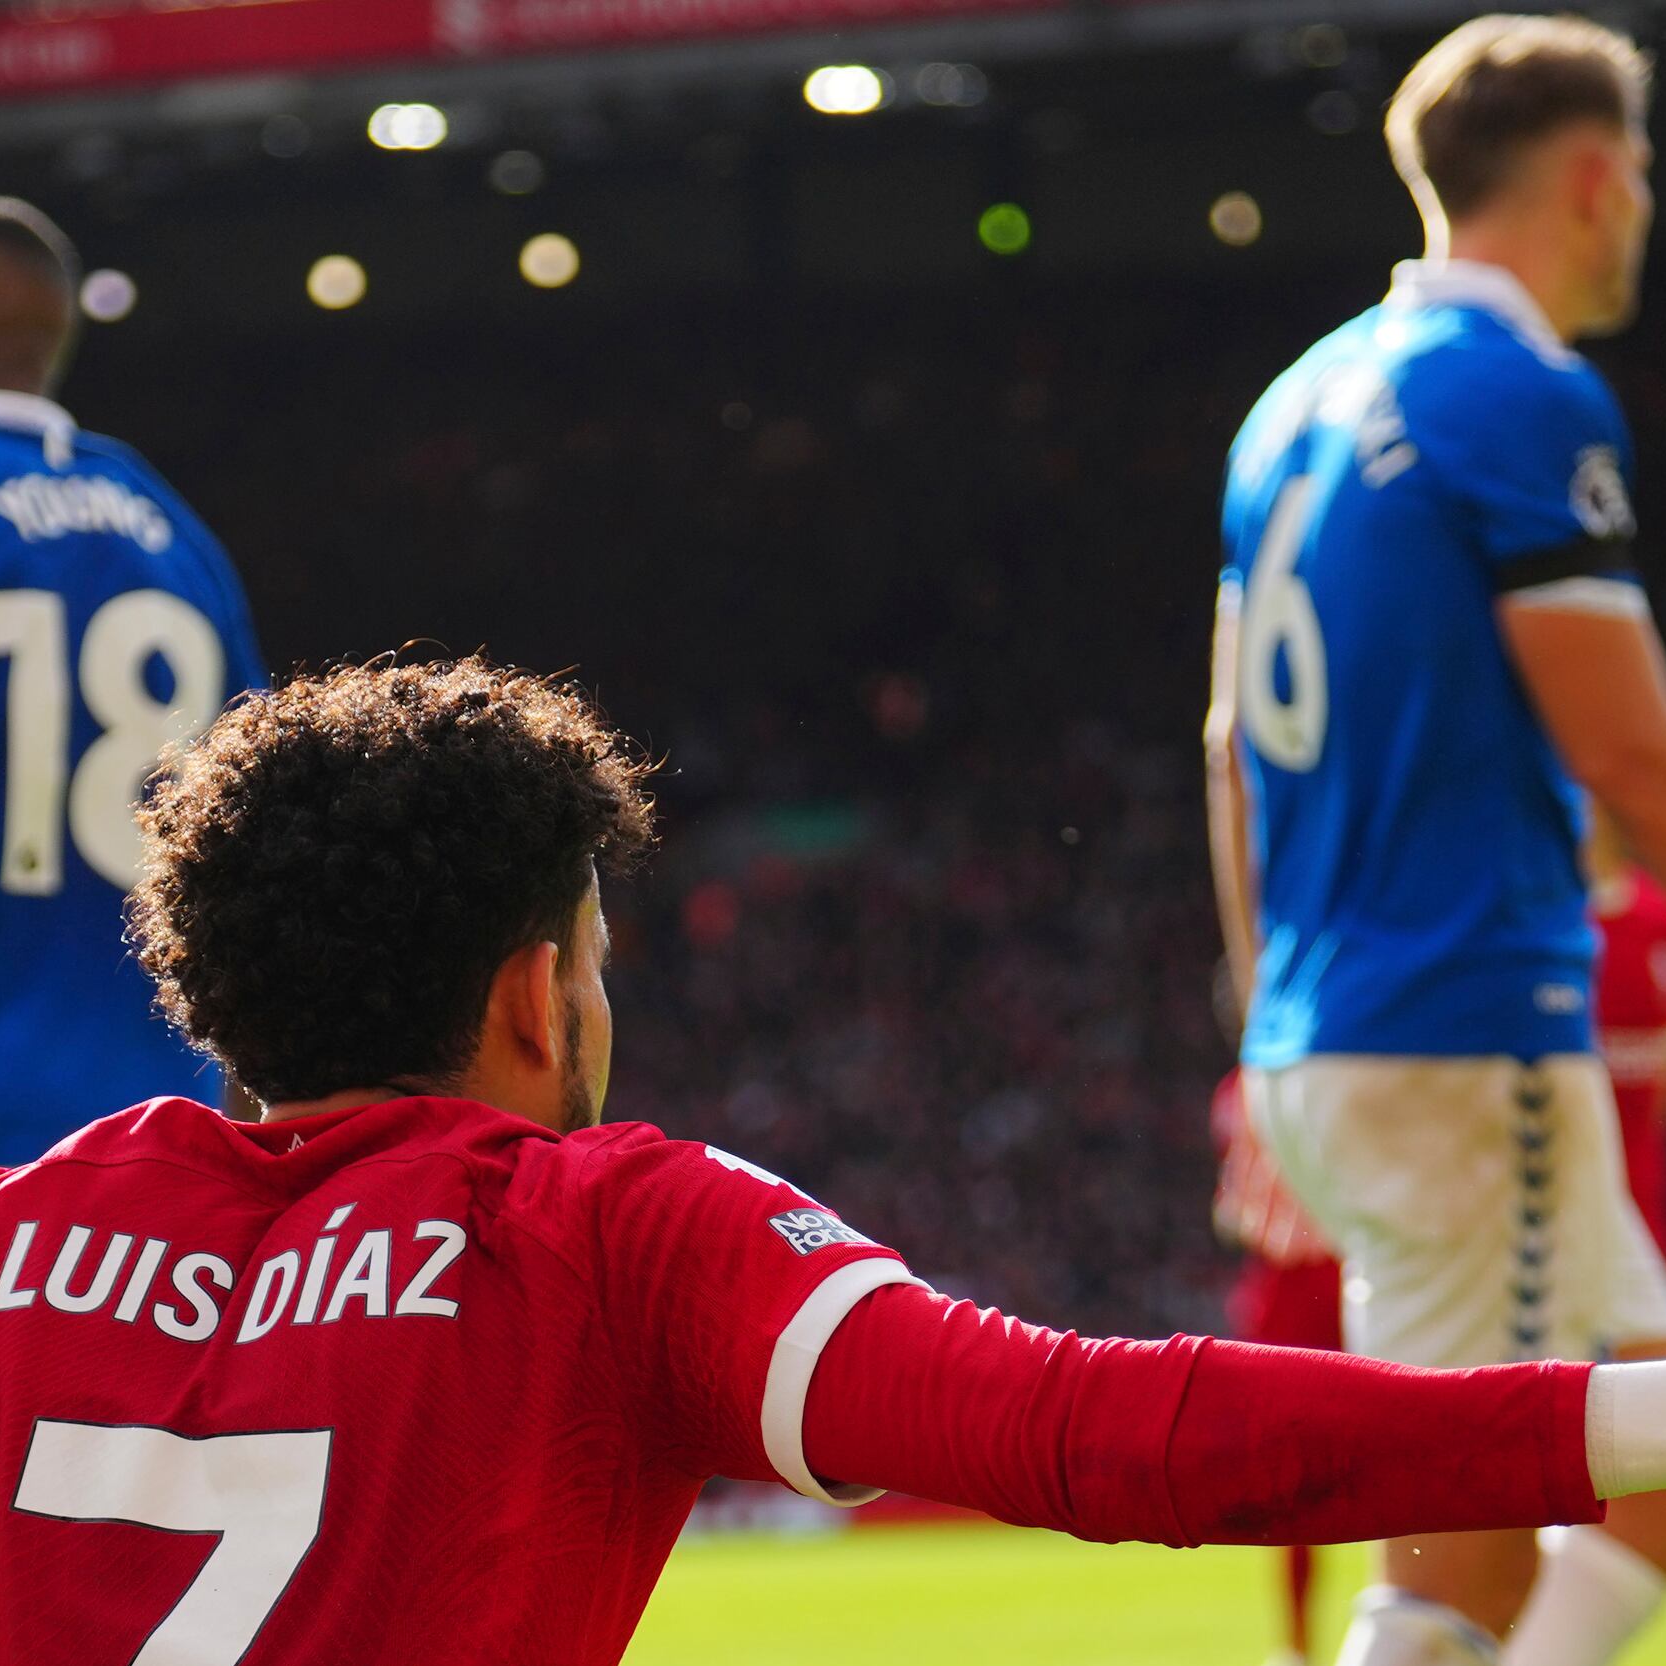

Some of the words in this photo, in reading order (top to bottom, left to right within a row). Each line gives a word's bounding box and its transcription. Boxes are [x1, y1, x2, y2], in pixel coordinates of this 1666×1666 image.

[1240, 473, 1329, 774] 6
[769, 1211, 824, 1238] No
[788, 1228, 838, 1255] for
[233, 1201, 467, 1345] DÍAZ
